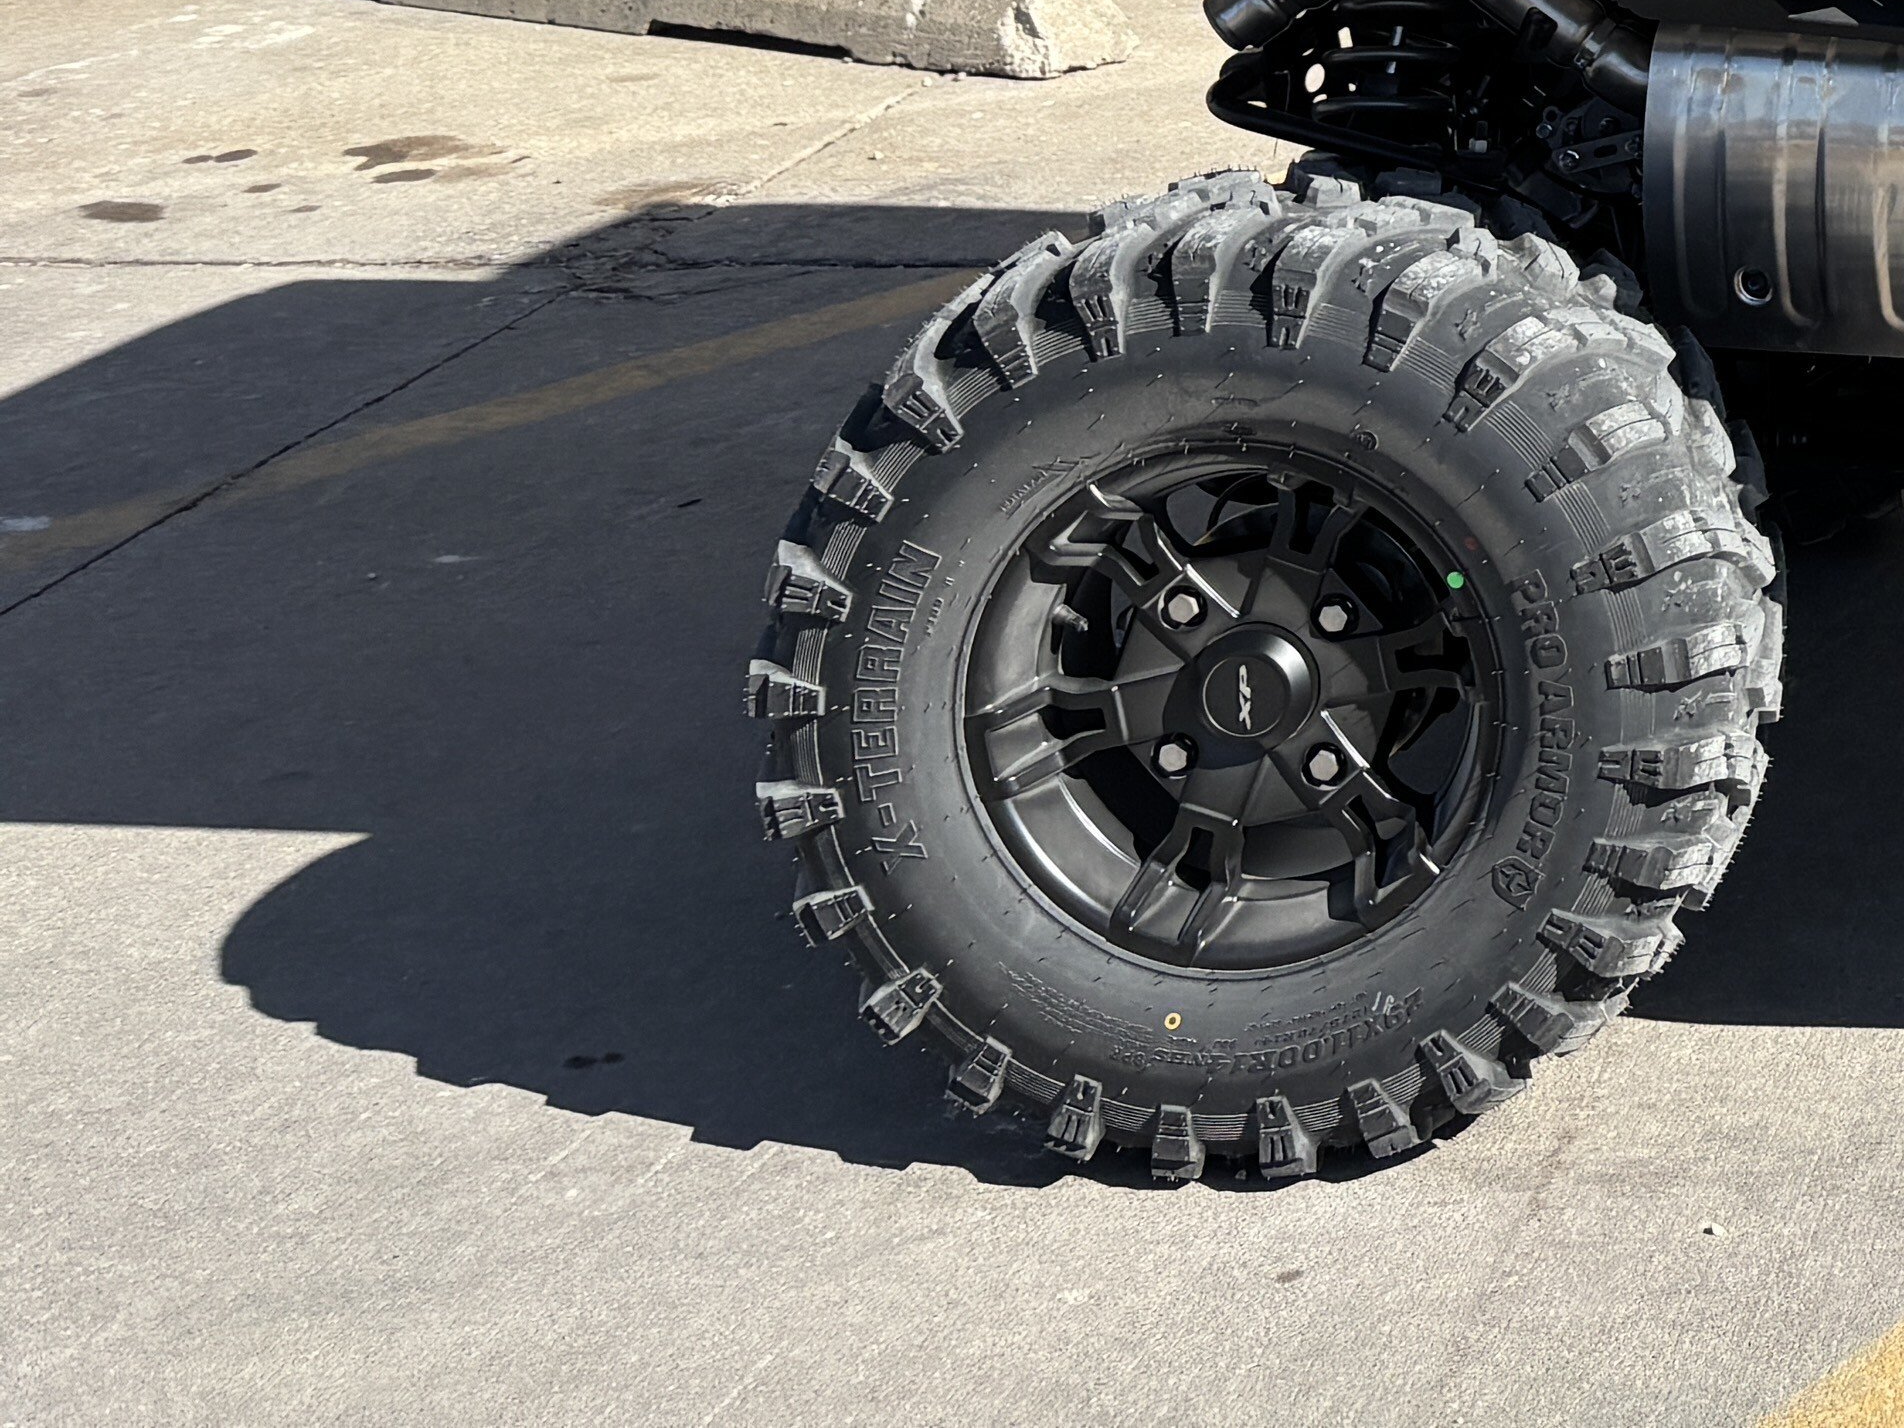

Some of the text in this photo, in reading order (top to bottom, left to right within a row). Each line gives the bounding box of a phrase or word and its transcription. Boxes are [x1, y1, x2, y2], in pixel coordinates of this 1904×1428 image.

[851, 539, 941, 875] X-TERRAIN
[1237, 664, 1253, 731] XP
[1508, 569, 1576, 861] PRO ARMOR
